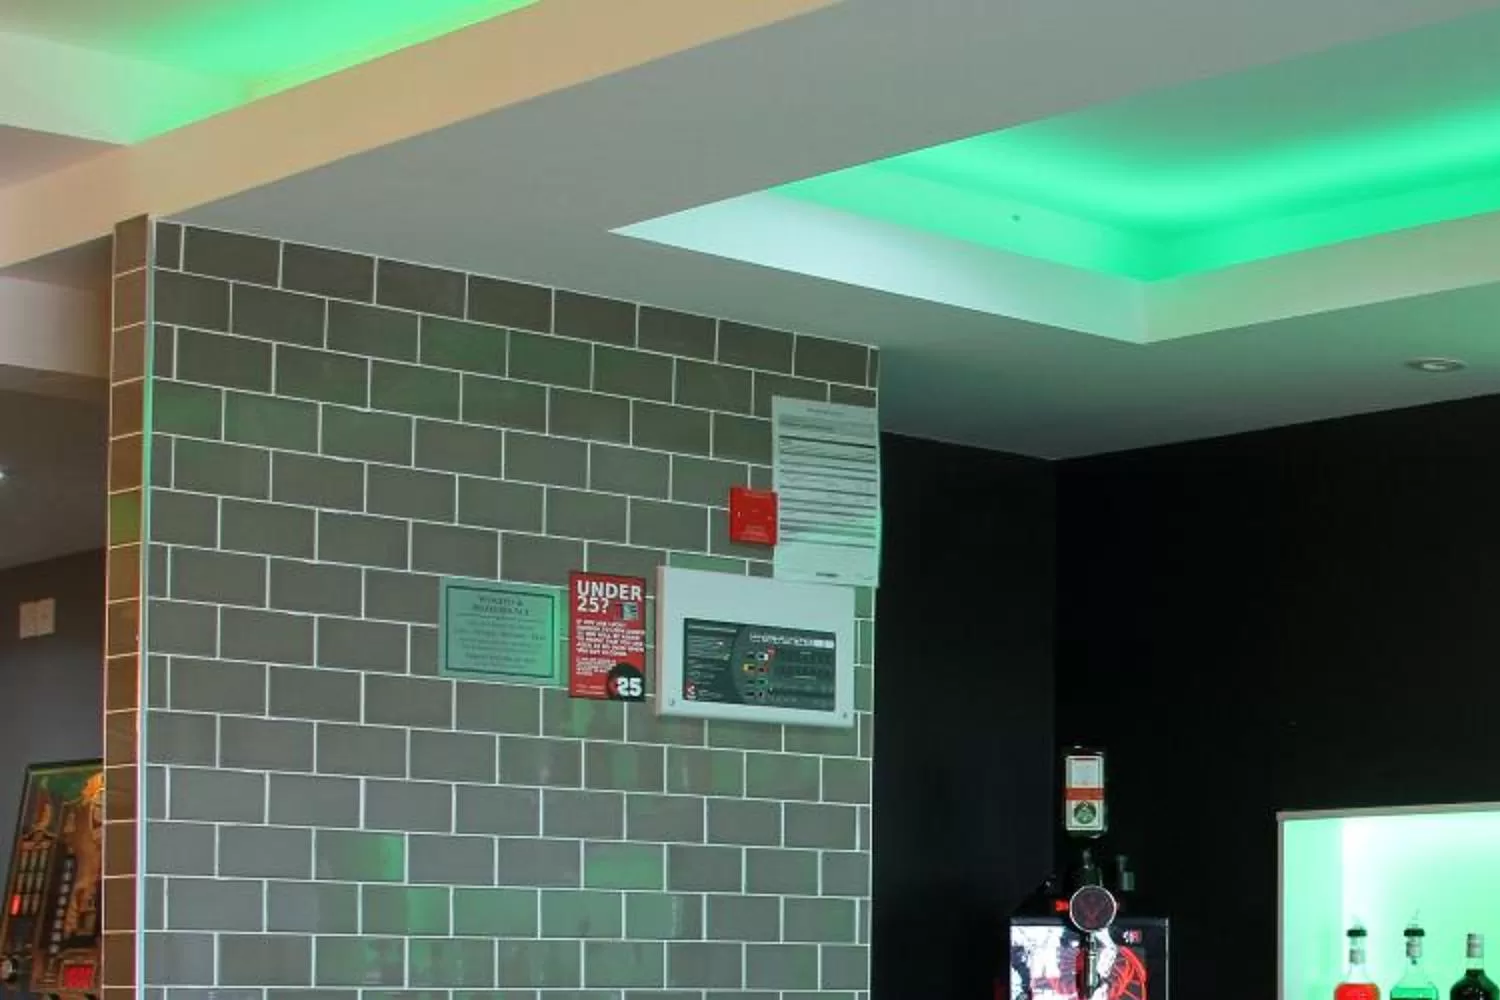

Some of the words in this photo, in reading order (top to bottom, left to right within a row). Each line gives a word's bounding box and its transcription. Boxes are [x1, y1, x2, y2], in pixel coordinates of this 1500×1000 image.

[577, 580, 642, 601] UNDER
[577, 596, 609, 614] 25?
[617, 677, 642, 696] 25
